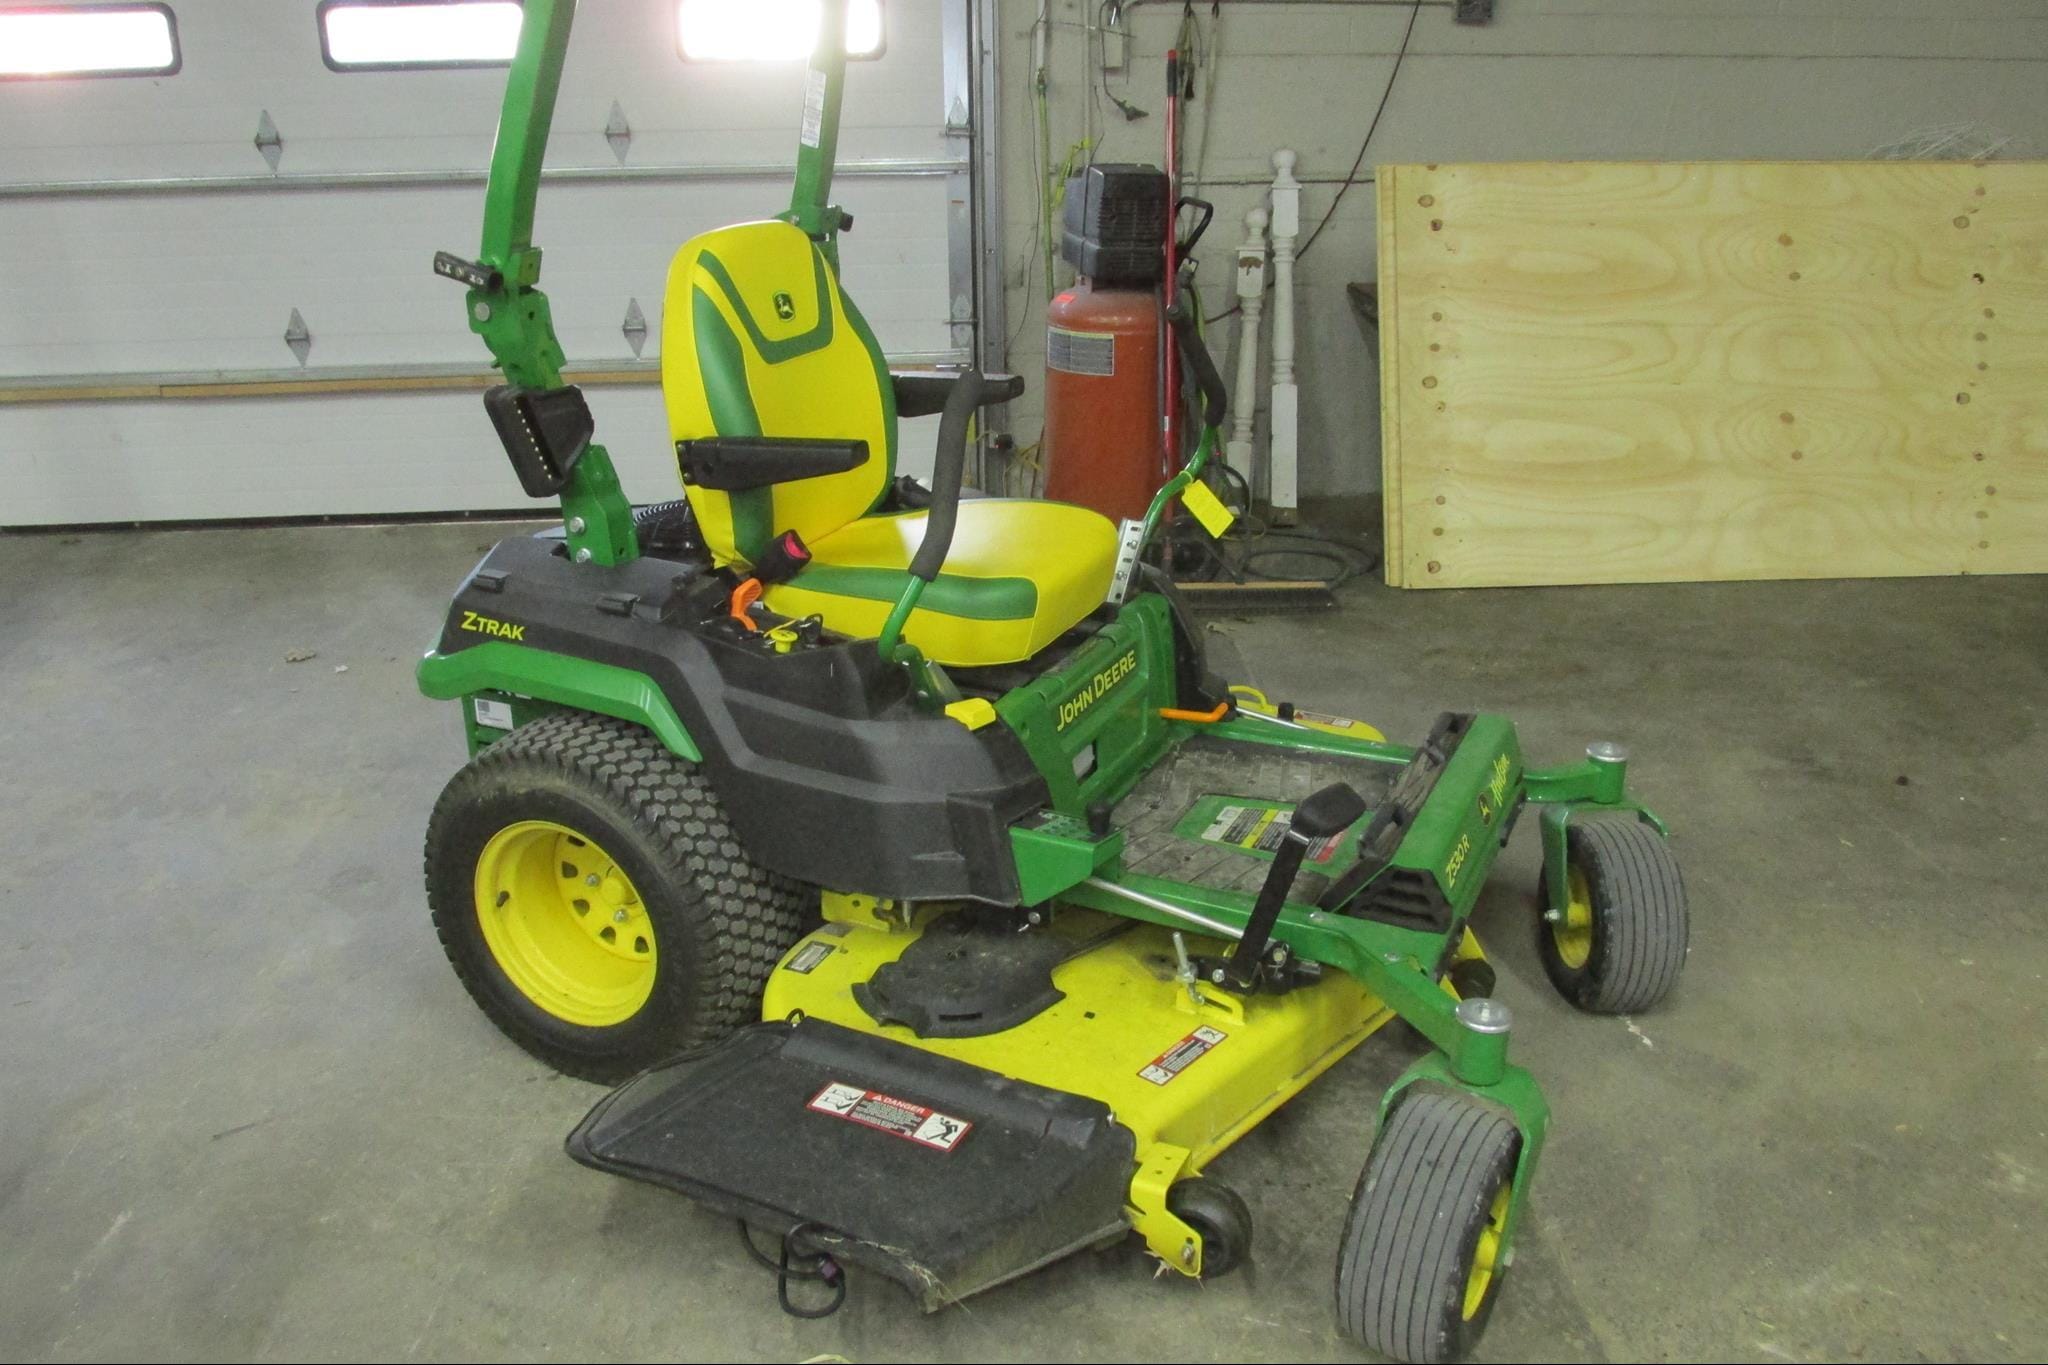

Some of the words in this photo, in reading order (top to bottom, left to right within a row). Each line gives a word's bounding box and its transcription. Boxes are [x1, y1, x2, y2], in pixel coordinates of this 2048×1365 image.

[461, 611, 524, 640] ZTRAK
[1057, 686, 1092, 731] JOHN
[1094, 651, 1135, 698] DEERE
[883, 1096, 926, 1113] DANGER
